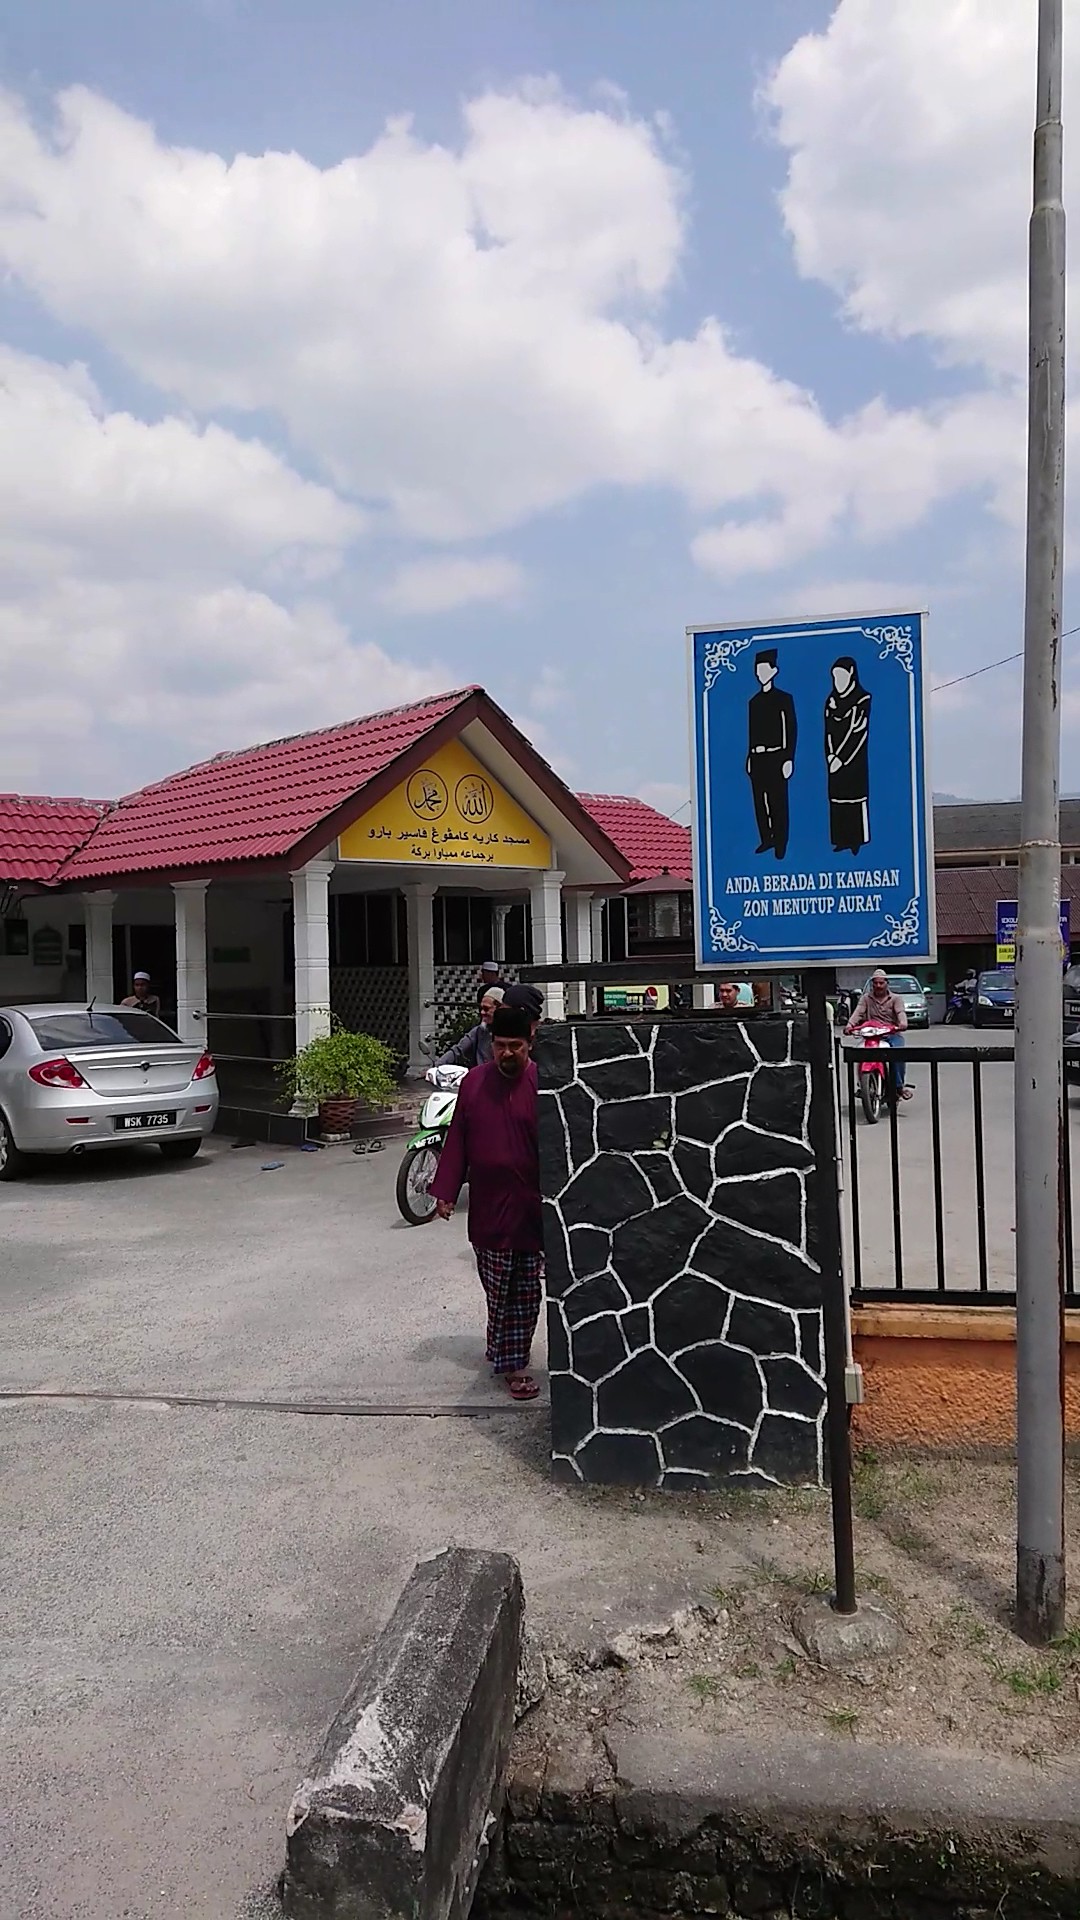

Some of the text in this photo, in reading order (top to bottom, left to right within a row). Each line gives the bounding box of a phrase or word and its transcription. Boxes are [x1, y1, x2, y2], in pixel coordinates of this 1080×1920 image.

[367, 825, 392, 839] بارو
[502, 835, 531, 846] مسجد
[725, 869, 900, 894] ANDA BERADA DI KAWASAN
[743, 894, 882, 917] ZON MENUTUP AURAT
[124, 1113, 169, 1128] WSK 7735
